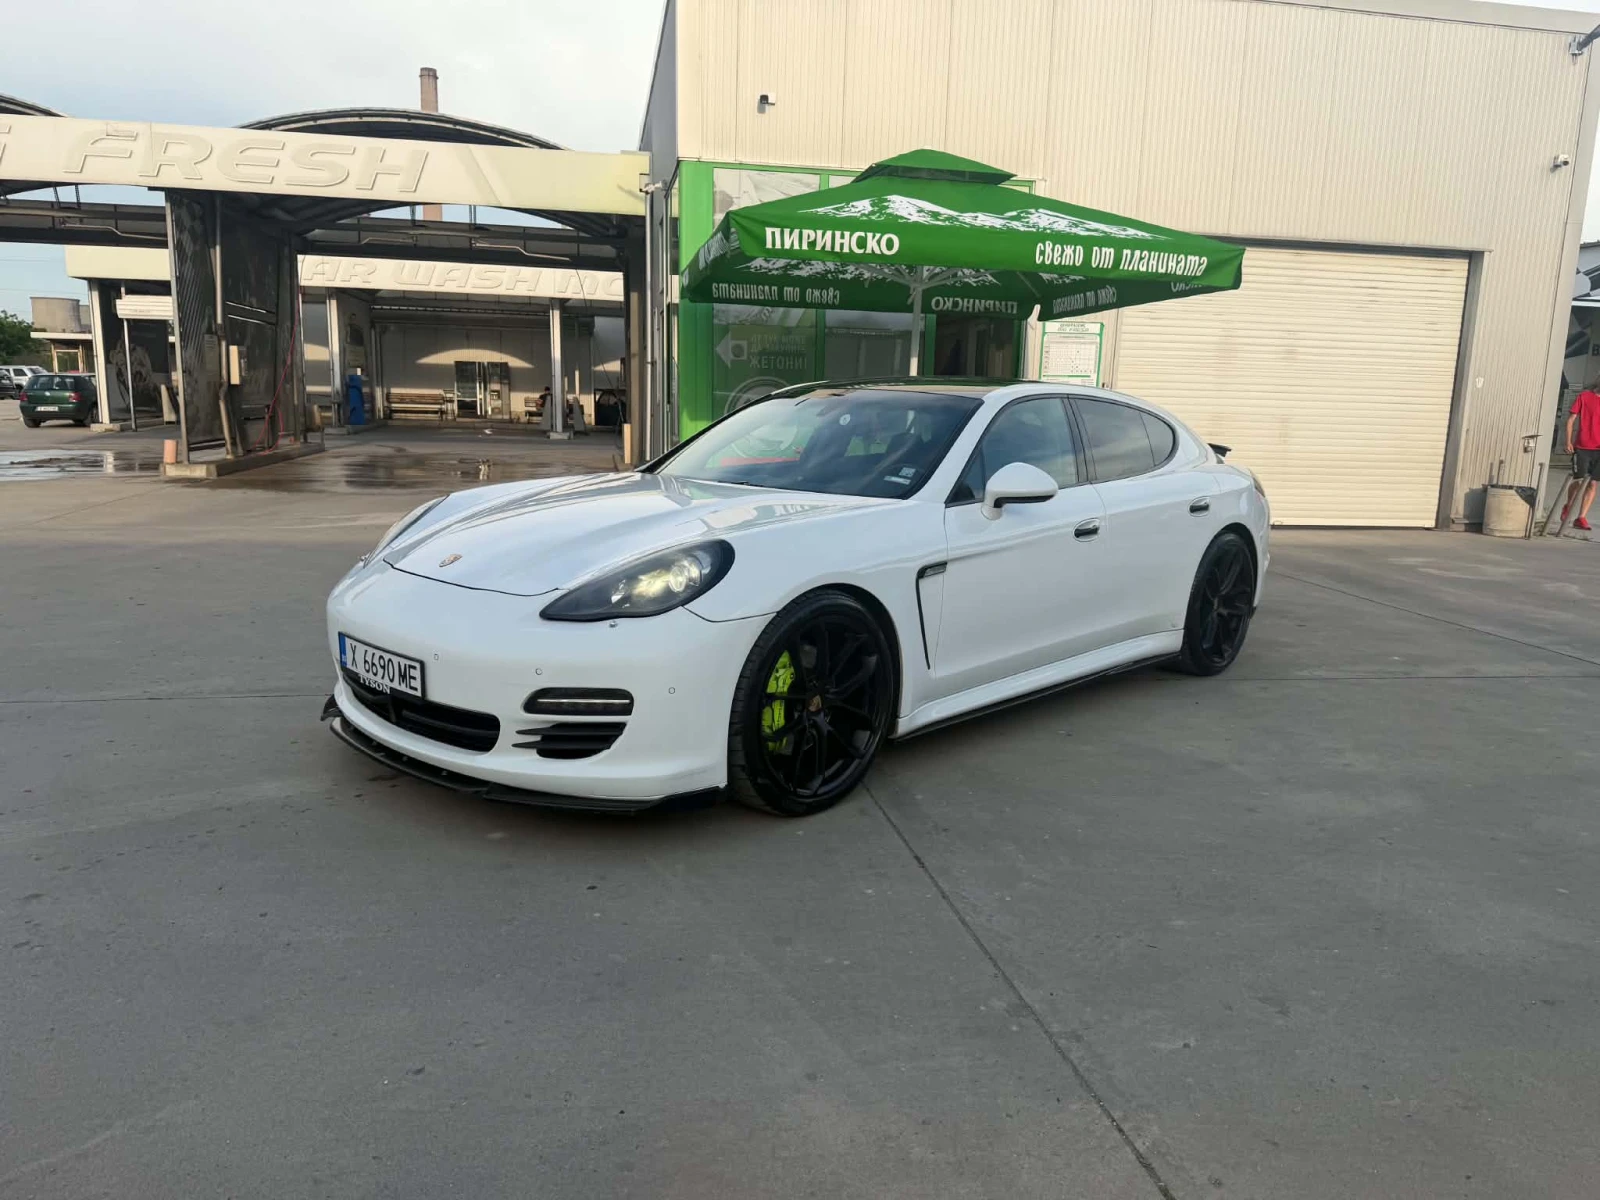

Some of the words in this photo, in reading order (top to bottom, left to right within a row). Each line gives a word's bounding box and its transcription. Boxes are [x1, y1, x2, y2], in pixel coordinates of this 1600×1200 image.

[63, 128, 428, 193] FRESH
[765, 226, 900, 255] ПИРИНСКО
[303, 259, 377, 284] AR
[394, 261, 542, 292] WASH
[1035, 240, 1084, 267] свежо
[1091, 246, 1115, 270] от
[1119, 248, 1208, 277] планината
[350, 643, 358, 669] X
[364, 650, 395, 683] 6690
[398, 661, 418, 691] ME
[359, 674, 391, 694] TYSON
